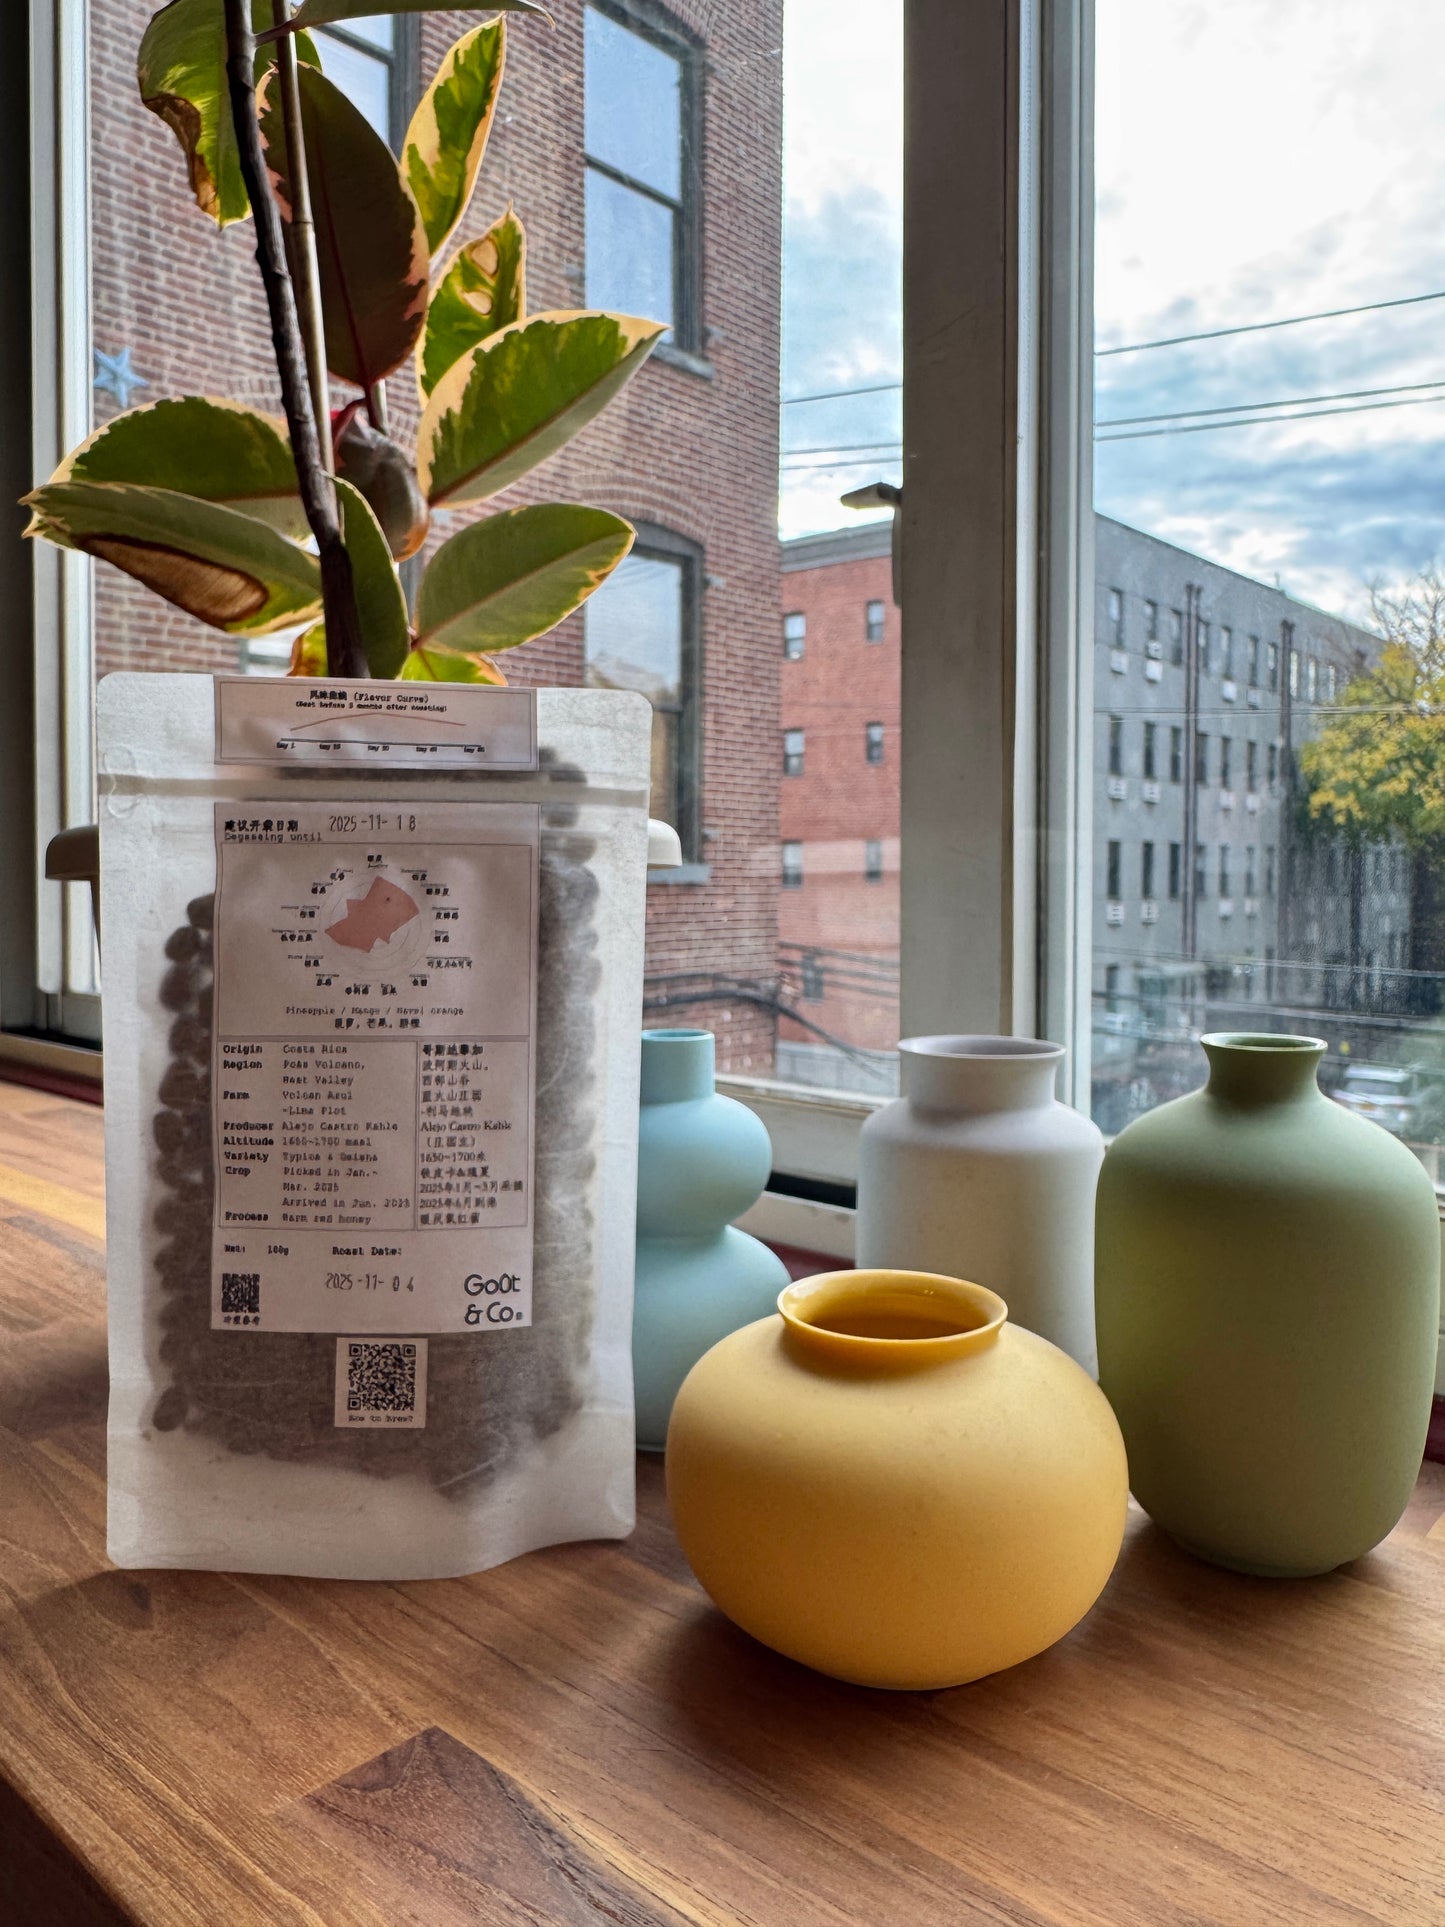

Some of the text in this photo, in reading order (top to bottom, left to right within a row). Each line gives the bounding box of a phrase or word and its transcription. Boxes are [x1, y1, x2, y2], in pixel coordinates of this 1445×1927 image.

[386, 703, 408, 711] after
[290, 832, 322, 842] until
[223, 1044, 263, 1056] Origin
[283, 1044, 348, 1055] Costa Rica
[223, 1060, 263, 1071] Region
[315, 1075, 354, 1087] Valley
[223, 1090, 250, 1101] Farm
[321, 1106, 347, 1116] Plot
[223, 1120, 275, 1132] Producer
[281, 1120, 315, 1133] Alejo
[320, 1121, 359, 1132] Castro
[223, 1135, 274, 1147] Altitude
[224, 1151, 269, 1163] Variety
[282, 1151, 321, 1164] Typica
[225, 1166, 251, 1178] Crop
[283, 1166, 322, 1177] Picked
[327, 1167, 340, 1178] in
[282, 1182, 308, 1192] Mar.
[282, 1198, 328, 1208] Arrived
[333, 1199, 346, 1209] in
[225, 1211, 269, 1222] Process
[314, 1213, 333, 1223] red
[338, 1213, 372, 1226] honey
[332, 1246, 402, 1256] Roast Date:
[464, 1301, 523, 1325] & Co.
